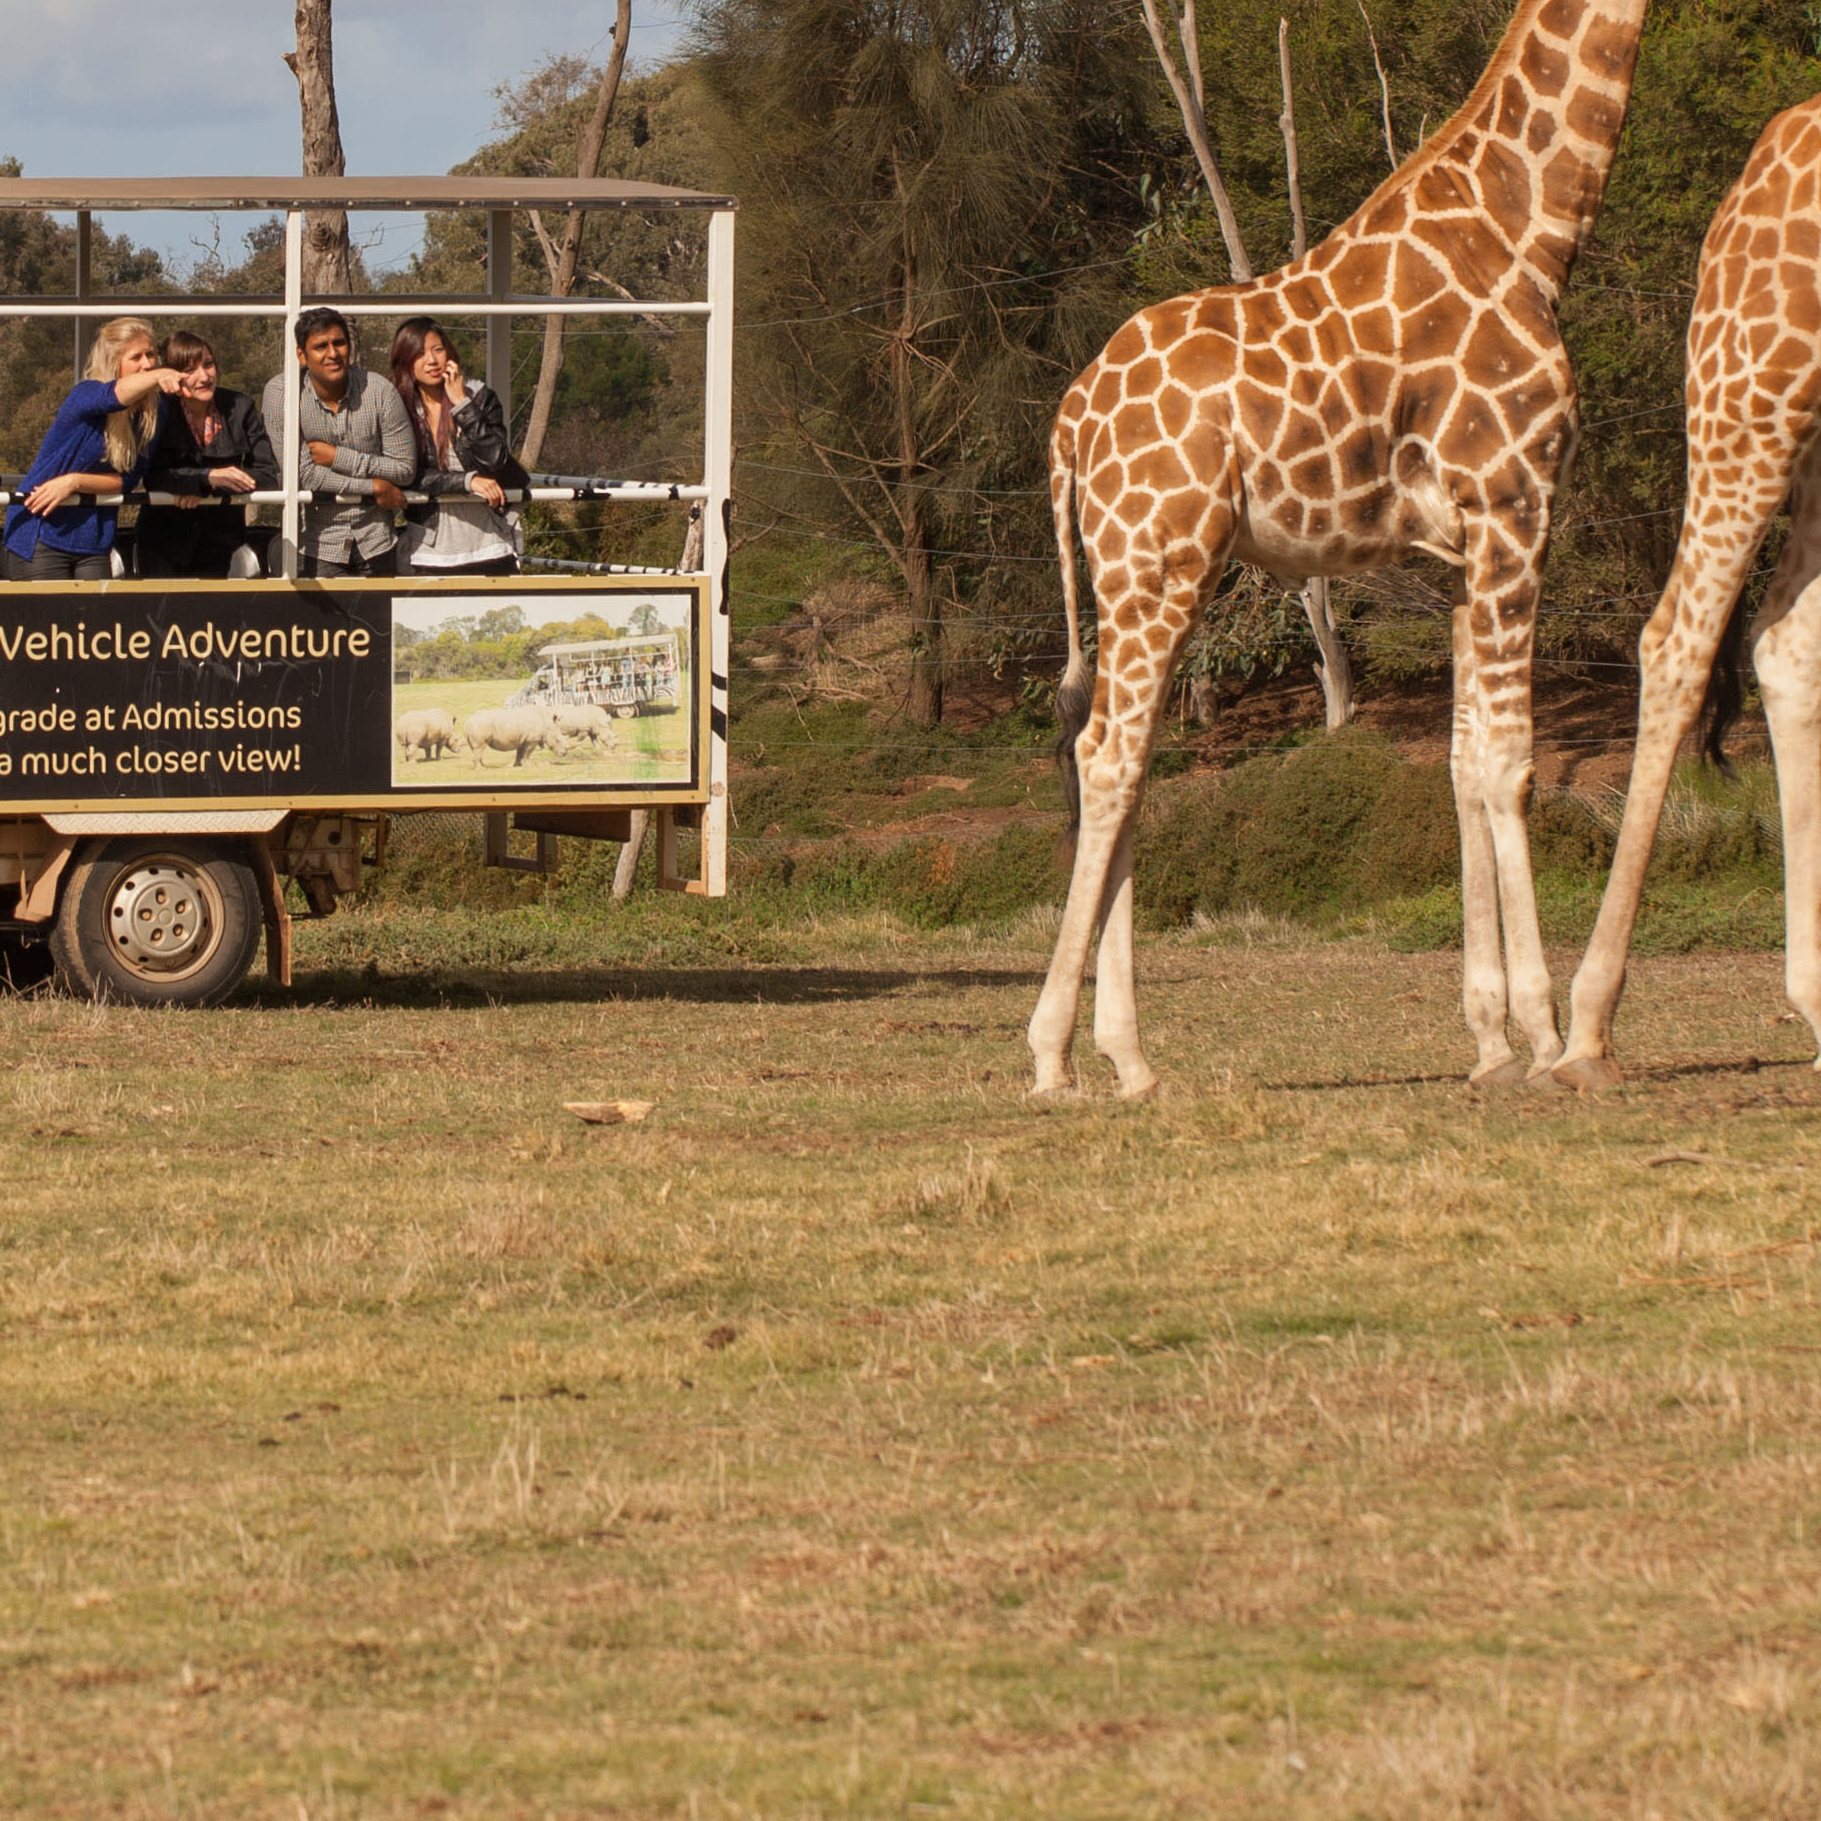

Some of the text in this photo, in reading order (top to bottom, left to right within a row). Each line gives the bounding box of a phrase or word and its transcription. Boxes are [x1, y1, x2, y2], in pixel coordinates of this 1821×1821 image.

[162, 622, 370, 661] Adventure
[85, 705, 116, 731] at
[123, 701, 301, 731] Admissions
[21, 746, 107, 775] much
[115, 745, 212, 774] closer
[217, 744, 301, 772] view!
